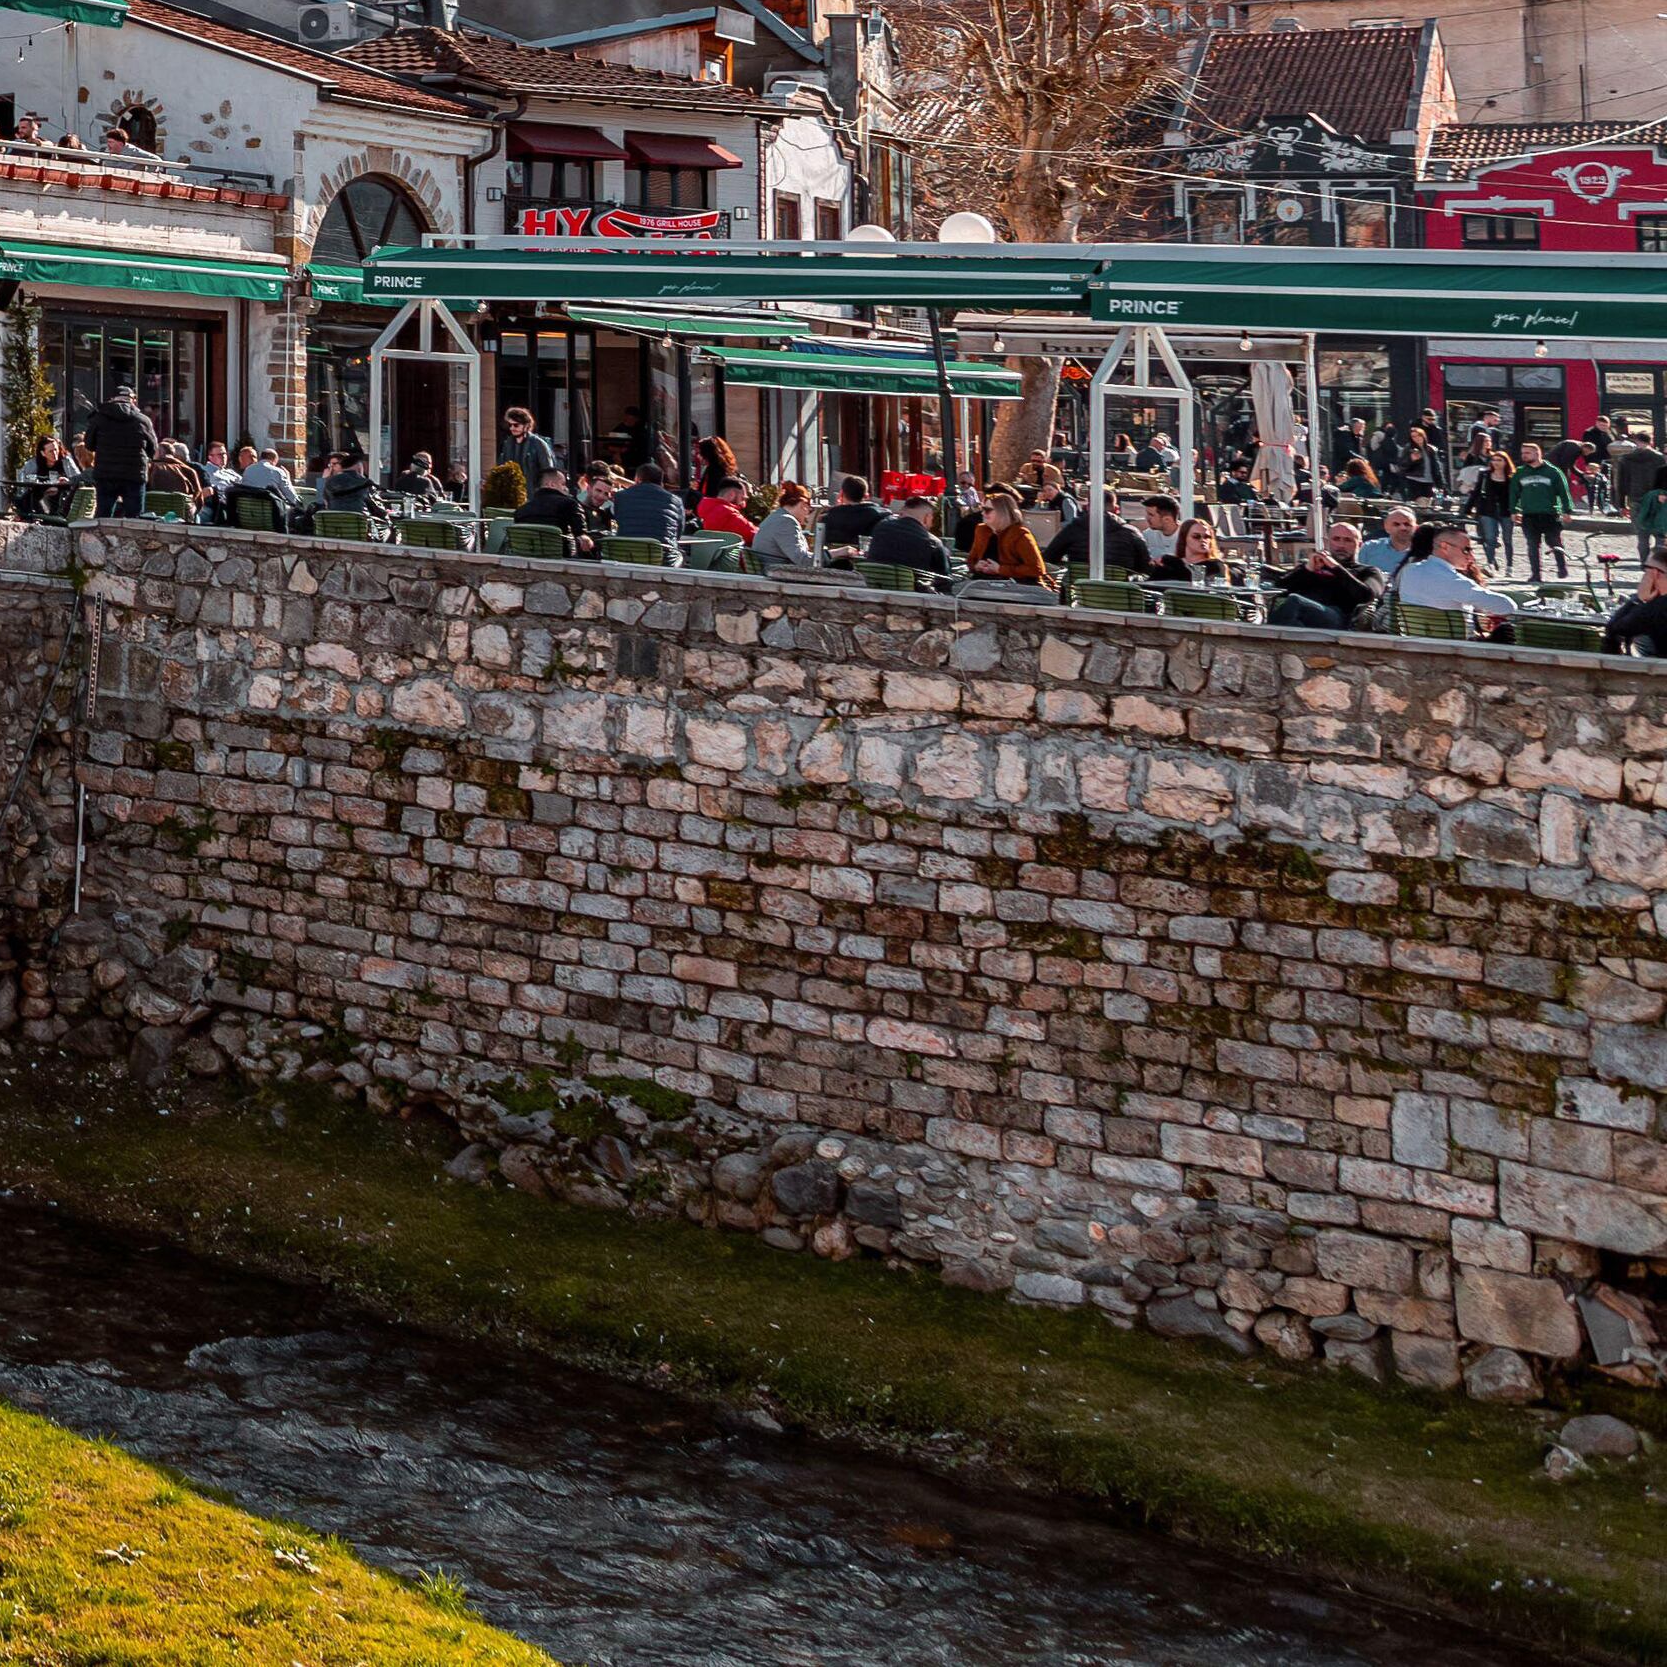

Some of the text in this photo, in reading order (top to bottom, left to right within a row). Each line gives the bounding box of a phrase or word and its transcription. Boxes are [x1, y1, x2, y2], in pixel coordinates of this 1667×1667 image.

[639, 217, 702, 228] 1976 GRILL HOUSE
[373, 275, 423, 289] PRINCE
[1109, 299, 1180, 315] PRINCE
